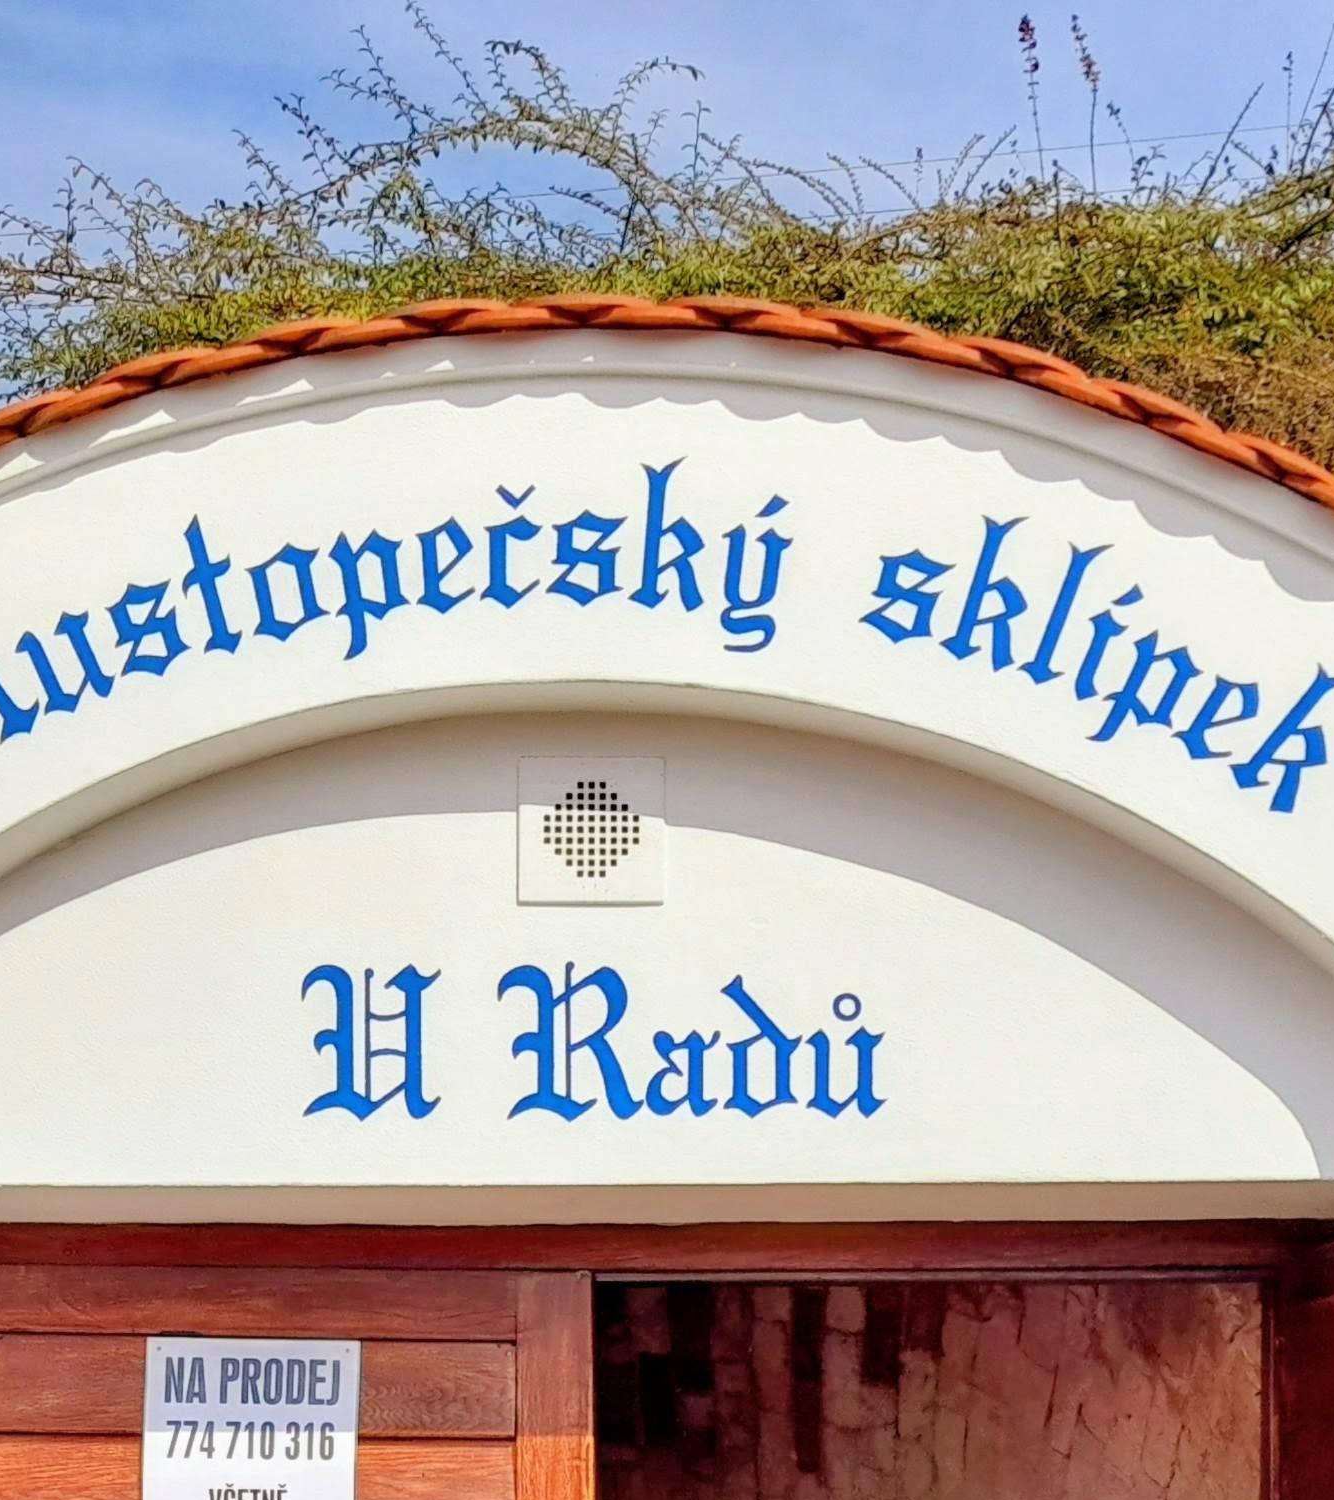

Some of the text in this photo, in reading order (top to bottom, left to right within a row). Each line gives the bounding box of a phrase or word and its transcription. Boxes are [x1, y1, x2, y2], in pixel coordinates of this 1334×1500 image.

[302, 960, 889, 1122] U Radů
[164, 1356, 342, 1406] NA PRODEJ
[166, 1420, 335, 1461] 774 710 316
